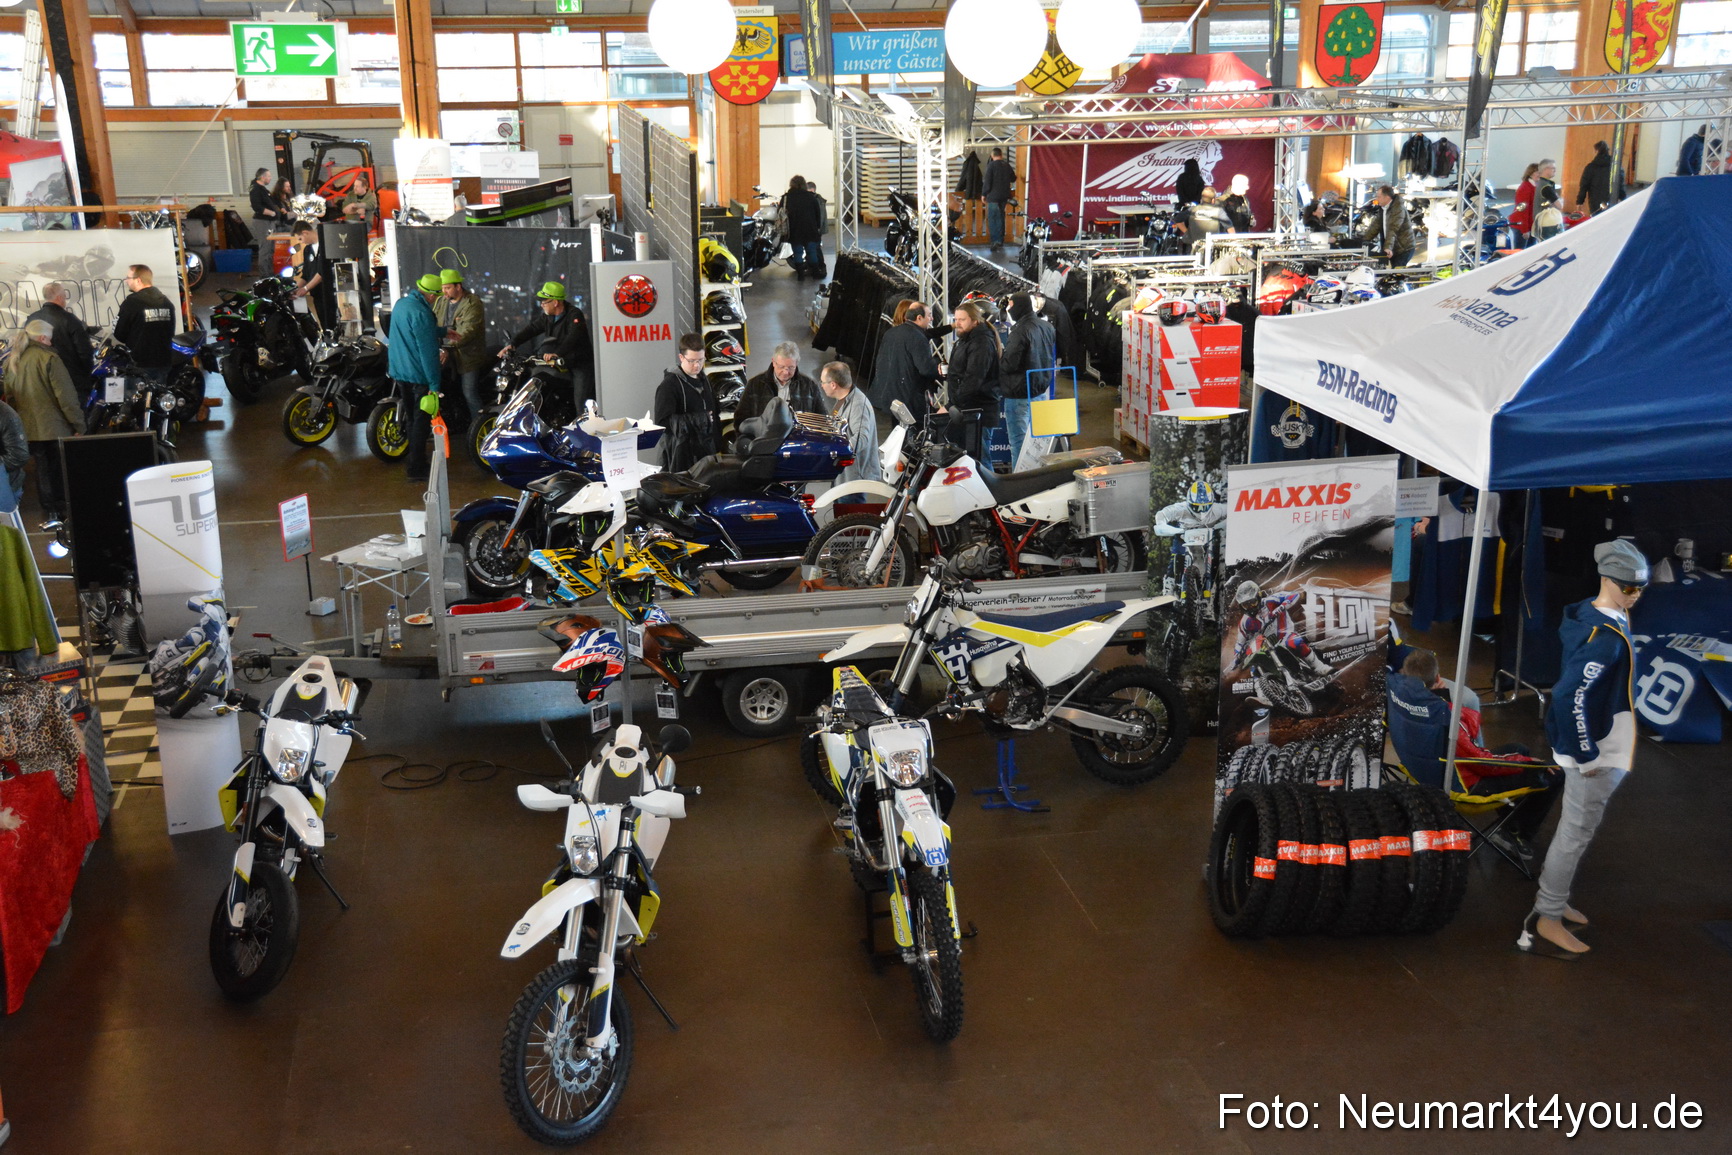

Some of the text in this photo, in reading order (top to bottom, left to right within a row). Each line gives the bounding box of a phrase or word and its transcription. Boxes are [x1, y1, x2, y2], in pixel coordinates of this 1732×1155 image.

[849, 31, 939, 57] Wir grüßen
[843, 53, 945, 71] unsere Gäste!
[602, 324, 672, 343] YAMAHA
[1316, 359, 1398, 424] BSN-Racing
[609, 467, 625, 477] 179€
[1234, 482, 1353, 513] MAXXIS
[1291, 509, 1353, 524] REIFEN
[969, 640, 999, 656] Husqvarna
[1322, 650, 1338, 660] FIND
